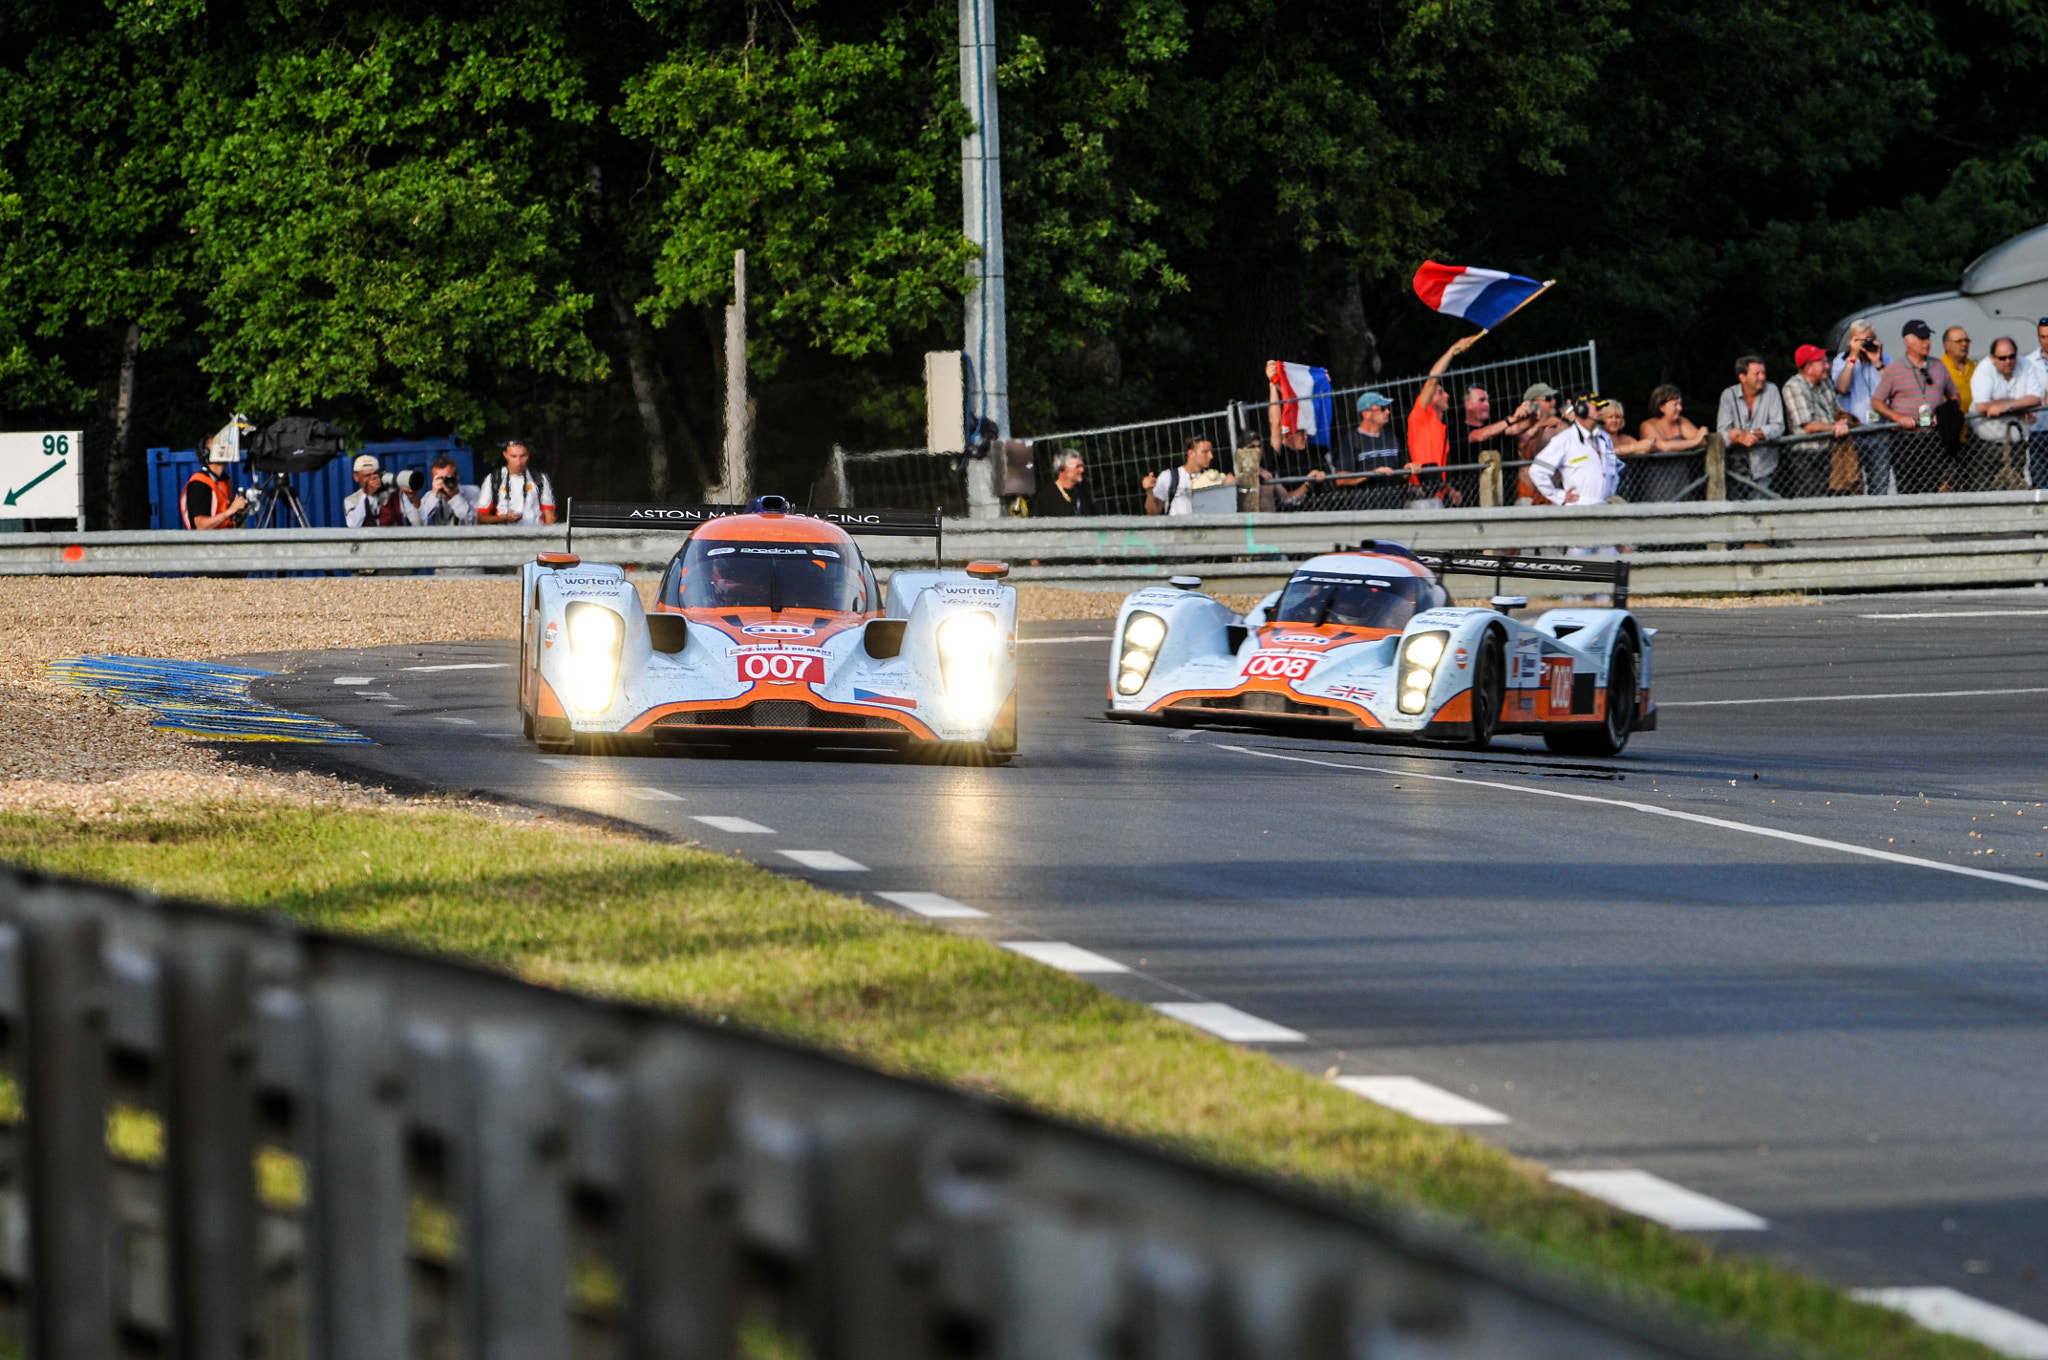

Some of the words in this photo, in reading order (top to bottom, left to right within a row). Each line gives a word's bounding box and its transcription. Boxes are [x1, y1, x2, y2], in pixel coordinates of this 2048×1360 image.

[42, 434, 69, 456] 96
[629, 509, 700, 519] ASTON
[795, 514, 881, 523] ACING
[1513, 561, 1584, 573] RACING
[564, 578, 615, 586] worten
[945, 587, 996, 595] worten
[743, 625, 814, 635] Gulf
[744, 655, 813, 679] 007
[1247, 656, 1309, 678] 008
